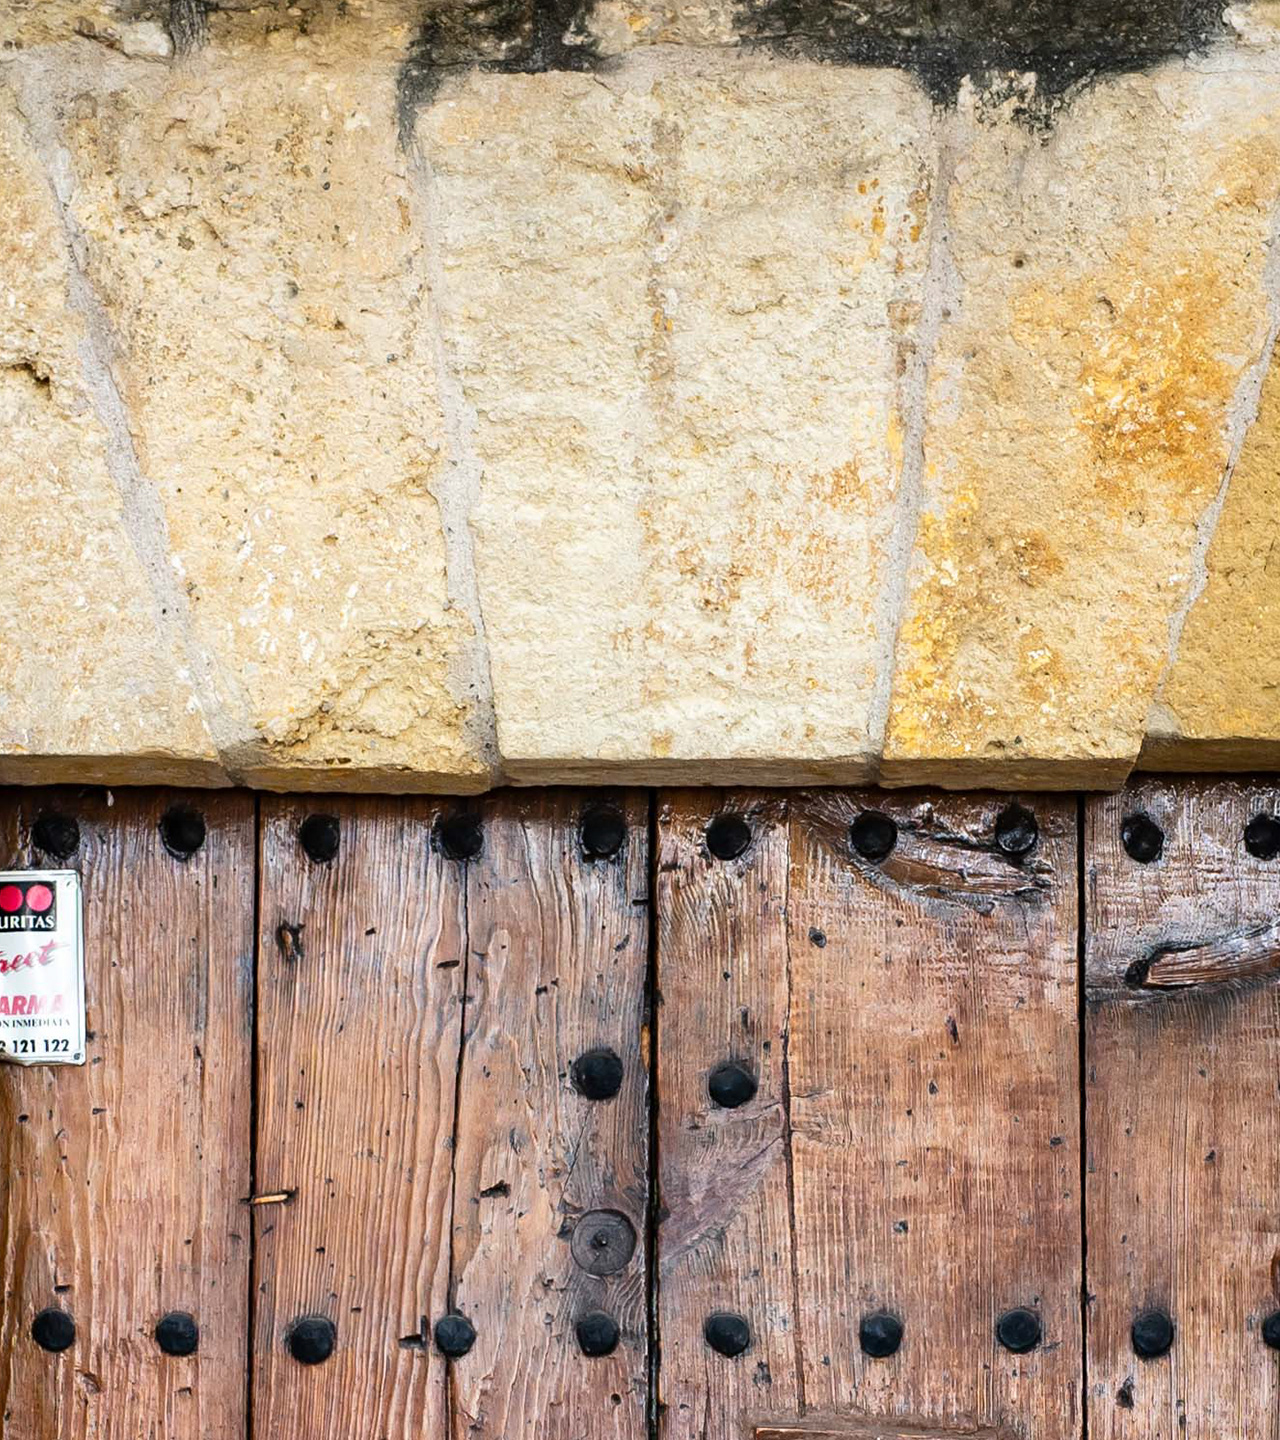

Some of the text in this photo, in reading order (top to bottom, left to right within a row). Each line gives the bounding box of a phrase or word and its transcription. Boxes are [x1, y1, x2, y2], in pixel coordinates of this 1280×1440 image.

[12, 1018, 70, 1029] INMEDIATA
[12, 1039, 36, 1053] 121
[43, 1039, 69, 1053] 122
